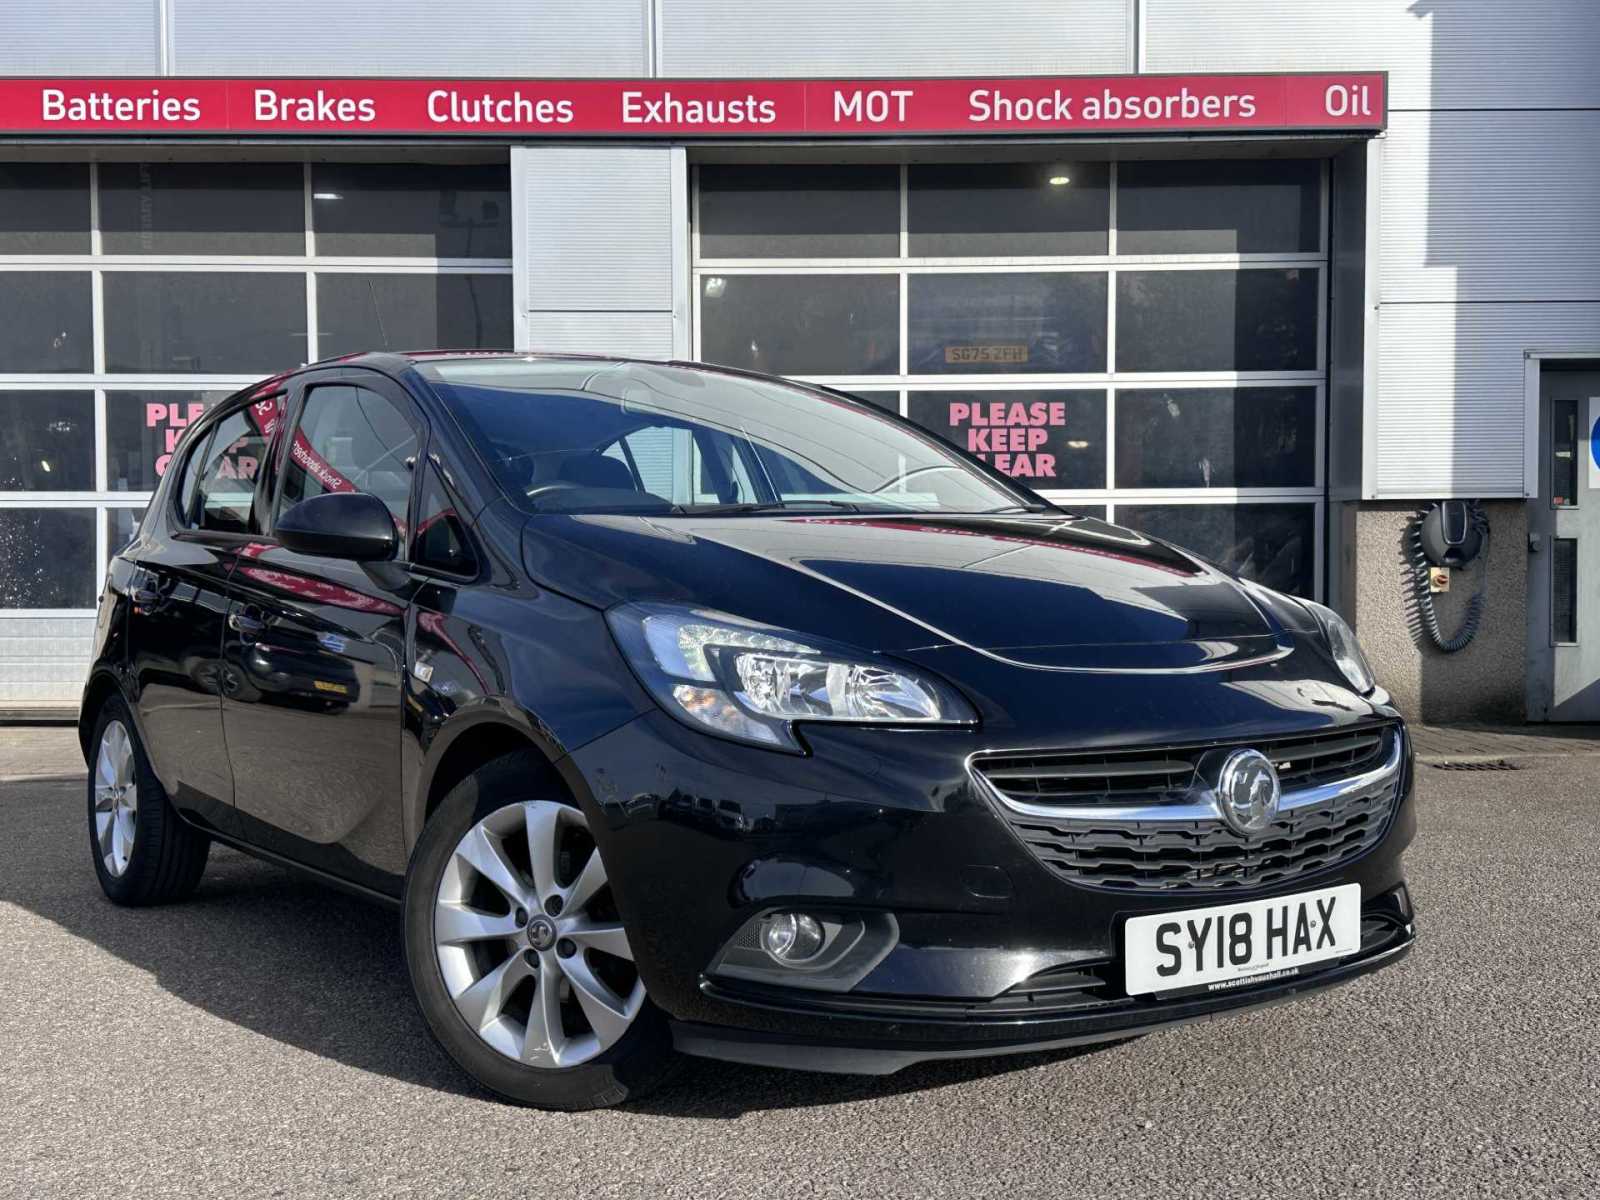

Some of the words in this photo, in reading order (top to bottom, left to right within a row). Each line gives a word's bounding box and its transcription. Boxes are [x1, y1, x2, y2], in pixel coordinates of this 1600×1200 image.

[42, 89, 201, 121] Batteries
[254, 89, 376, 122] Brakes
[427, 89, 574, 124] Clutches
[622, 91, 776, 124] Exhausts
[834, 90, 914, 122] MOT
[969, 89, 1073, 122] Shock
[1082, 87, 1256, 120] absorbers
[1325, 84, 1372, 117] Oil
[949, 402, 1066, 426] PLEASE
[967, 428, 1048, 452] KEEP
[1156, 911, 1253, 977] SY18
[1266, 896, 1337, 960] HAX
